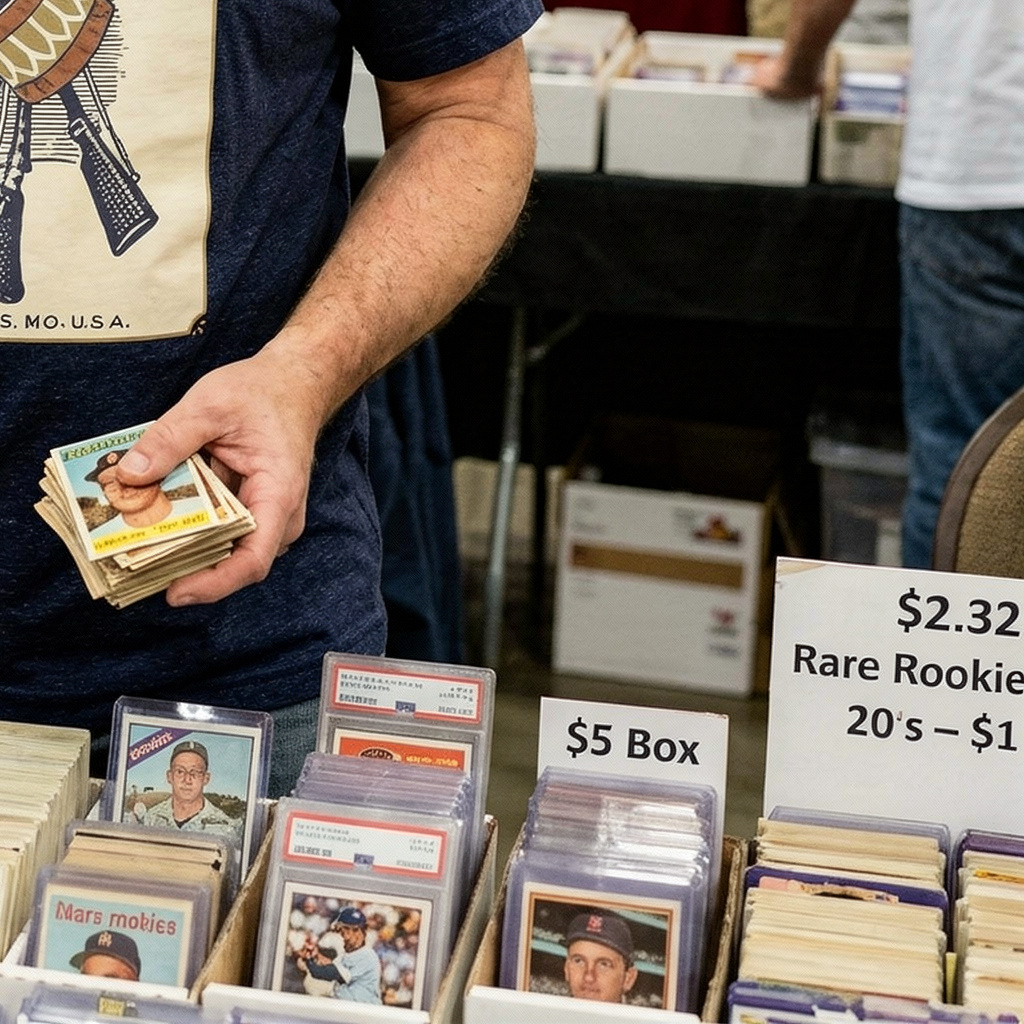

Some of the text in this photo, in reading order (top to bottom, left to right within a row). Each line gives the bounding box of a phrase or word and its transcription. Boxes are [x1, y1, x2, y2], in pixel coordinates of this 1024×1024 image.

[897, 587, 1021, 637] $2.32
[793, 643, 880, 681] Rare
[566, 716, 700, 766] $5 Box
[847, 704, 924, 743] 20's
[971, 712, 1018, 754] $1
